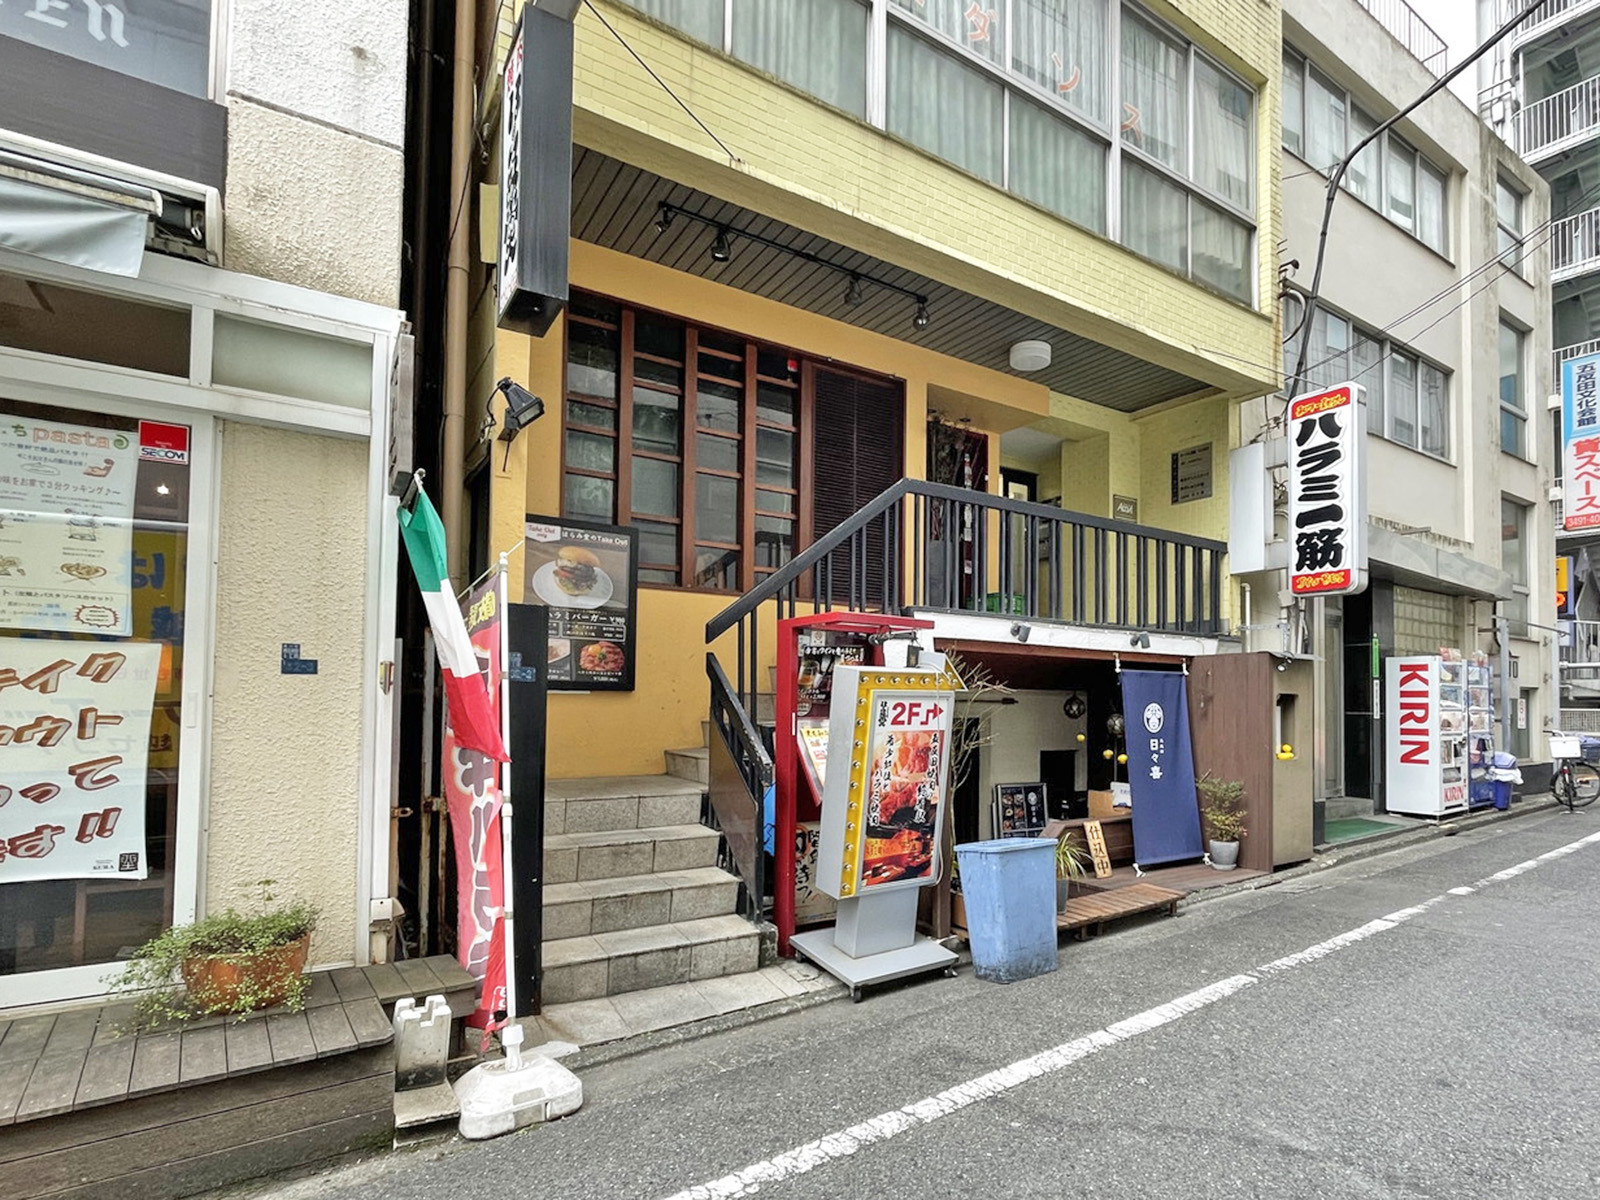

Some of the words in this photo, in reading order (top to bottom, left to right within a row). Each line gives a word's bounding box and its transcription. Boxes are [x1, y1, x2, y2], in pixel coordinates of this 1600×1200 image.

[1576, 361, 1597, 428] 五反田文化会館
[33, 427, 110, 449] pasta
[141, 447, 185, 460] SECOM
[1295, 412, 1344, 572] ハラミ一筋
[890, 702, 922, 726] 2F
[1399, 663, 1430, 765] KIRIN
[1443, 786, 1465, 803] KIRIN
[1089, 825, 1109, 875] 仕込中
